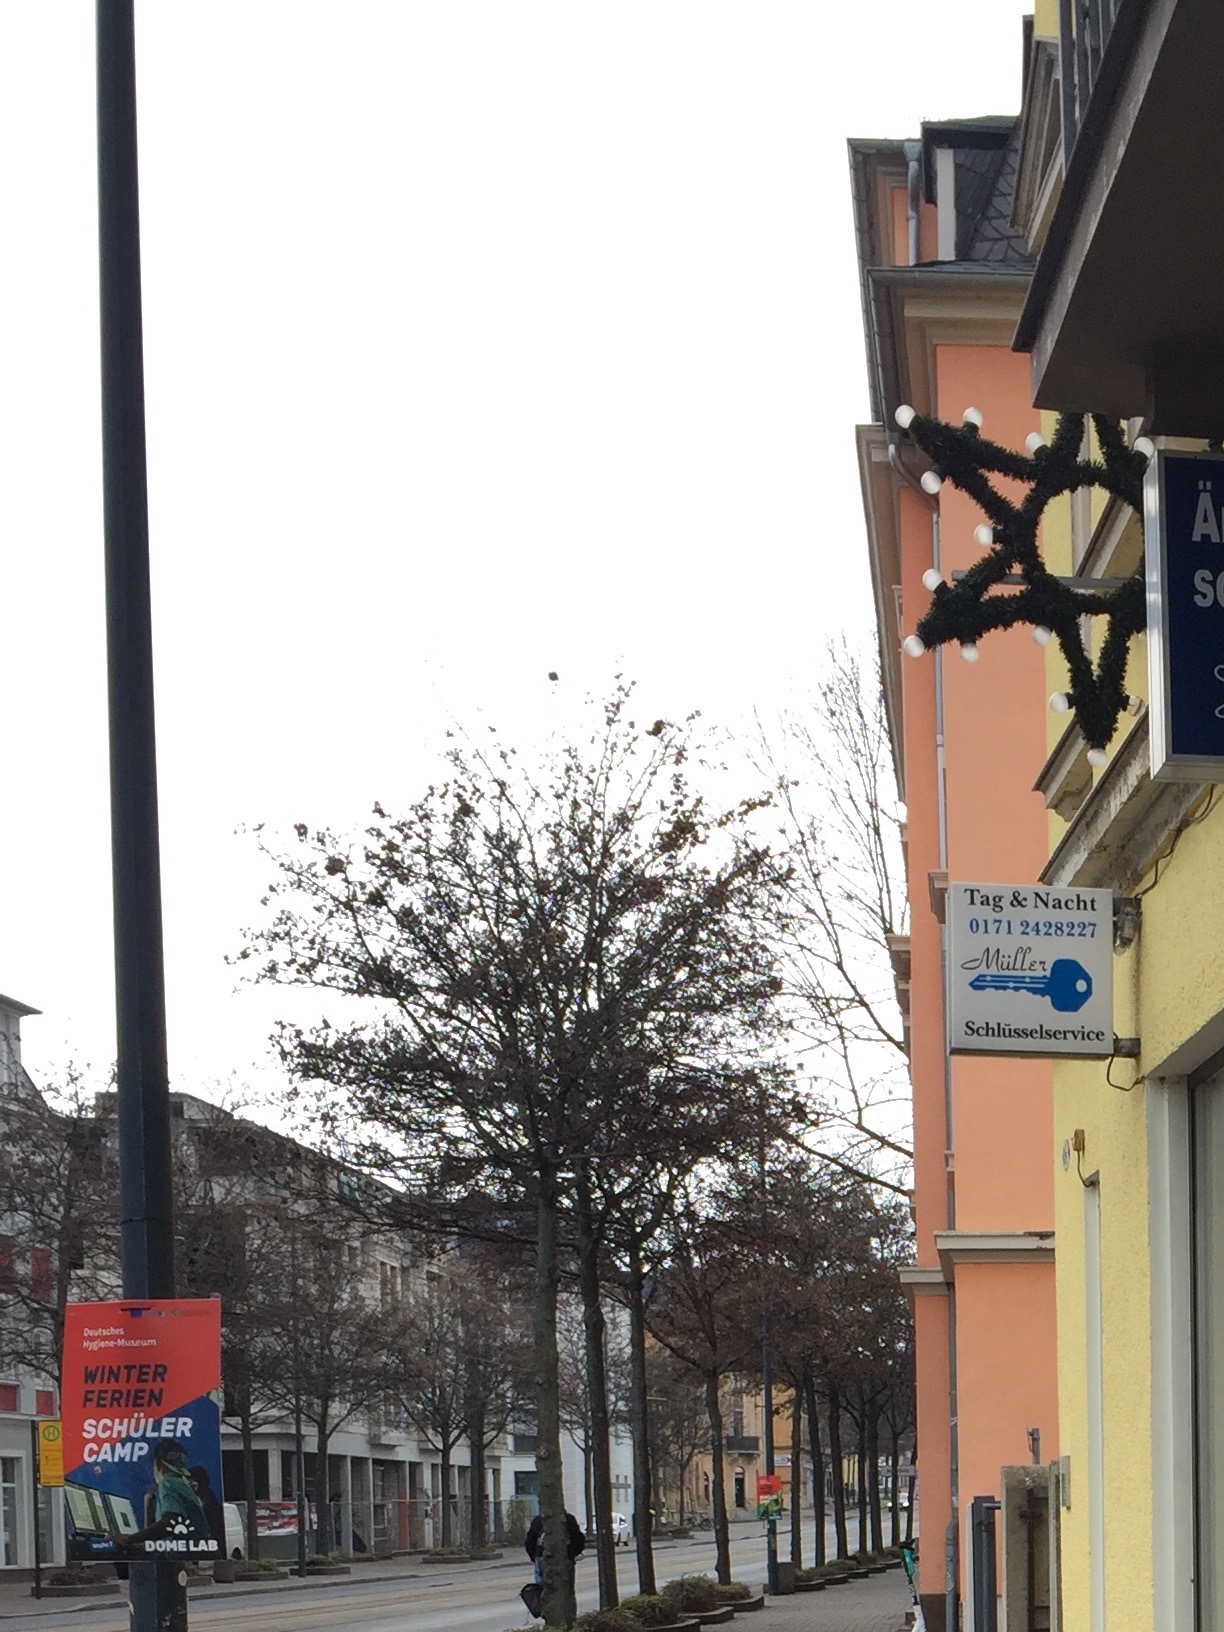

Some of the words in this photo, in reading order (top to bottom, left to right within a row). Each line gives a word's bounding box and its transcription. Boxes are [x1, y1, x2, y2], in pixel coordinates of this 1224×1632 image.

[963, 888, 1004, 913] Tag
[1010, 890, 1028, 908] &
[1033, 891, 1098, 912] Nacht
[969, 917, 1014, 935] 0171
[1020, 918, 1098, 938] 2428227
[960, 946, 1048, 972] Müller
[963, 1020, 1106, 1042] Schlüsselservice
[83, 1326, 125, 1337] Deutsches
[82, 1338, 157, 1350] Hygiene-Museum
[83, 1363, 168, 1384] WINTER
[82, 1387, 164, 1408] FERIEN
[81, 1412, 193, 1439] SCHÜLER
[82, 1442, 149, 1463] CAMP
[145, 1539, 187, 1552] DOME
[188, 1539, 219, 1552] LAB
